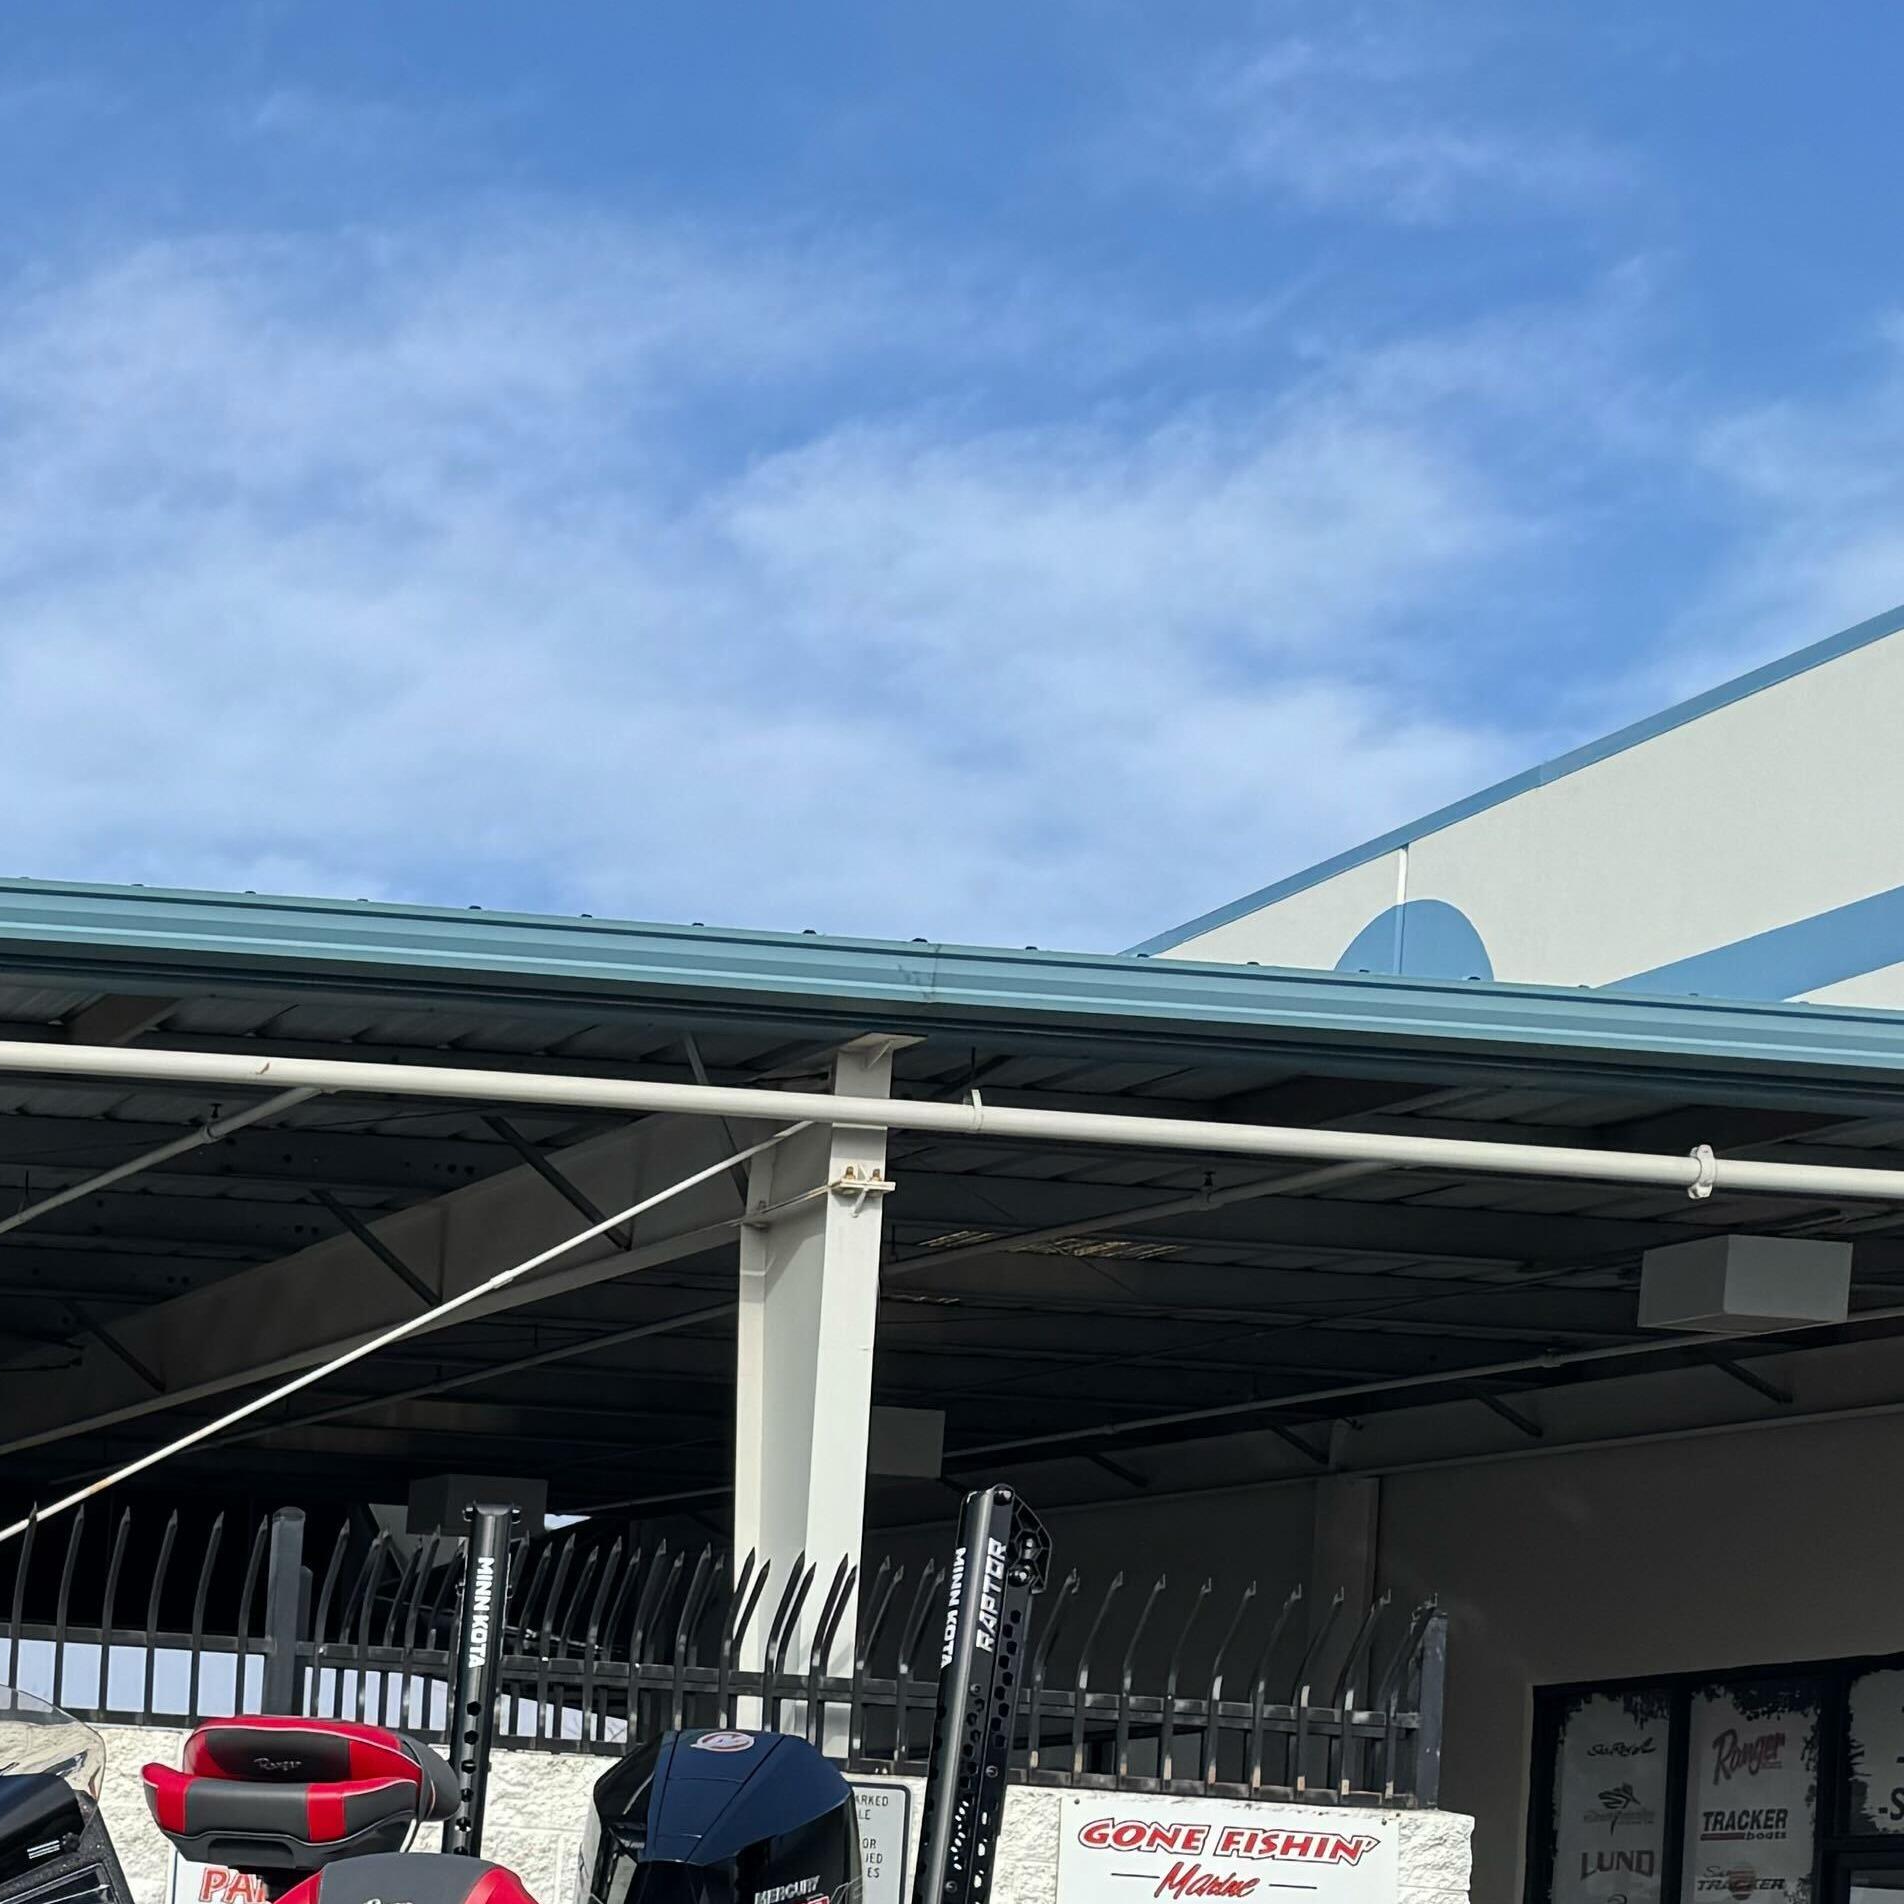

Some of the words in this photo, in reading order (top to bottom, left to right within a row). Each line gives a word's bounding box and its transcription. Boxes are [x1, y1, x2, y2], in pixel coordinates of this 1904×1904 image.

[473, 1557, 494, 1611] MINN
[949, 1547, 967, 1607] MINN
[976, 1537, 1007, 1652] RAPTOR
[468, 1615, 490, 1668] KOTA
[941, 1609, 959, 1669] KOTA
[855, 1795, 889, 1807] ARKED
[1702, 1808, 1789, 1832] TRACKER
[1078, 1817, 1211, 1855] GONE
[1746, 1831, 1787, 1840] boats
[1154, 1861, 1260, 1899] Marine
[1581, 1850, 1655, 1880] LUND
